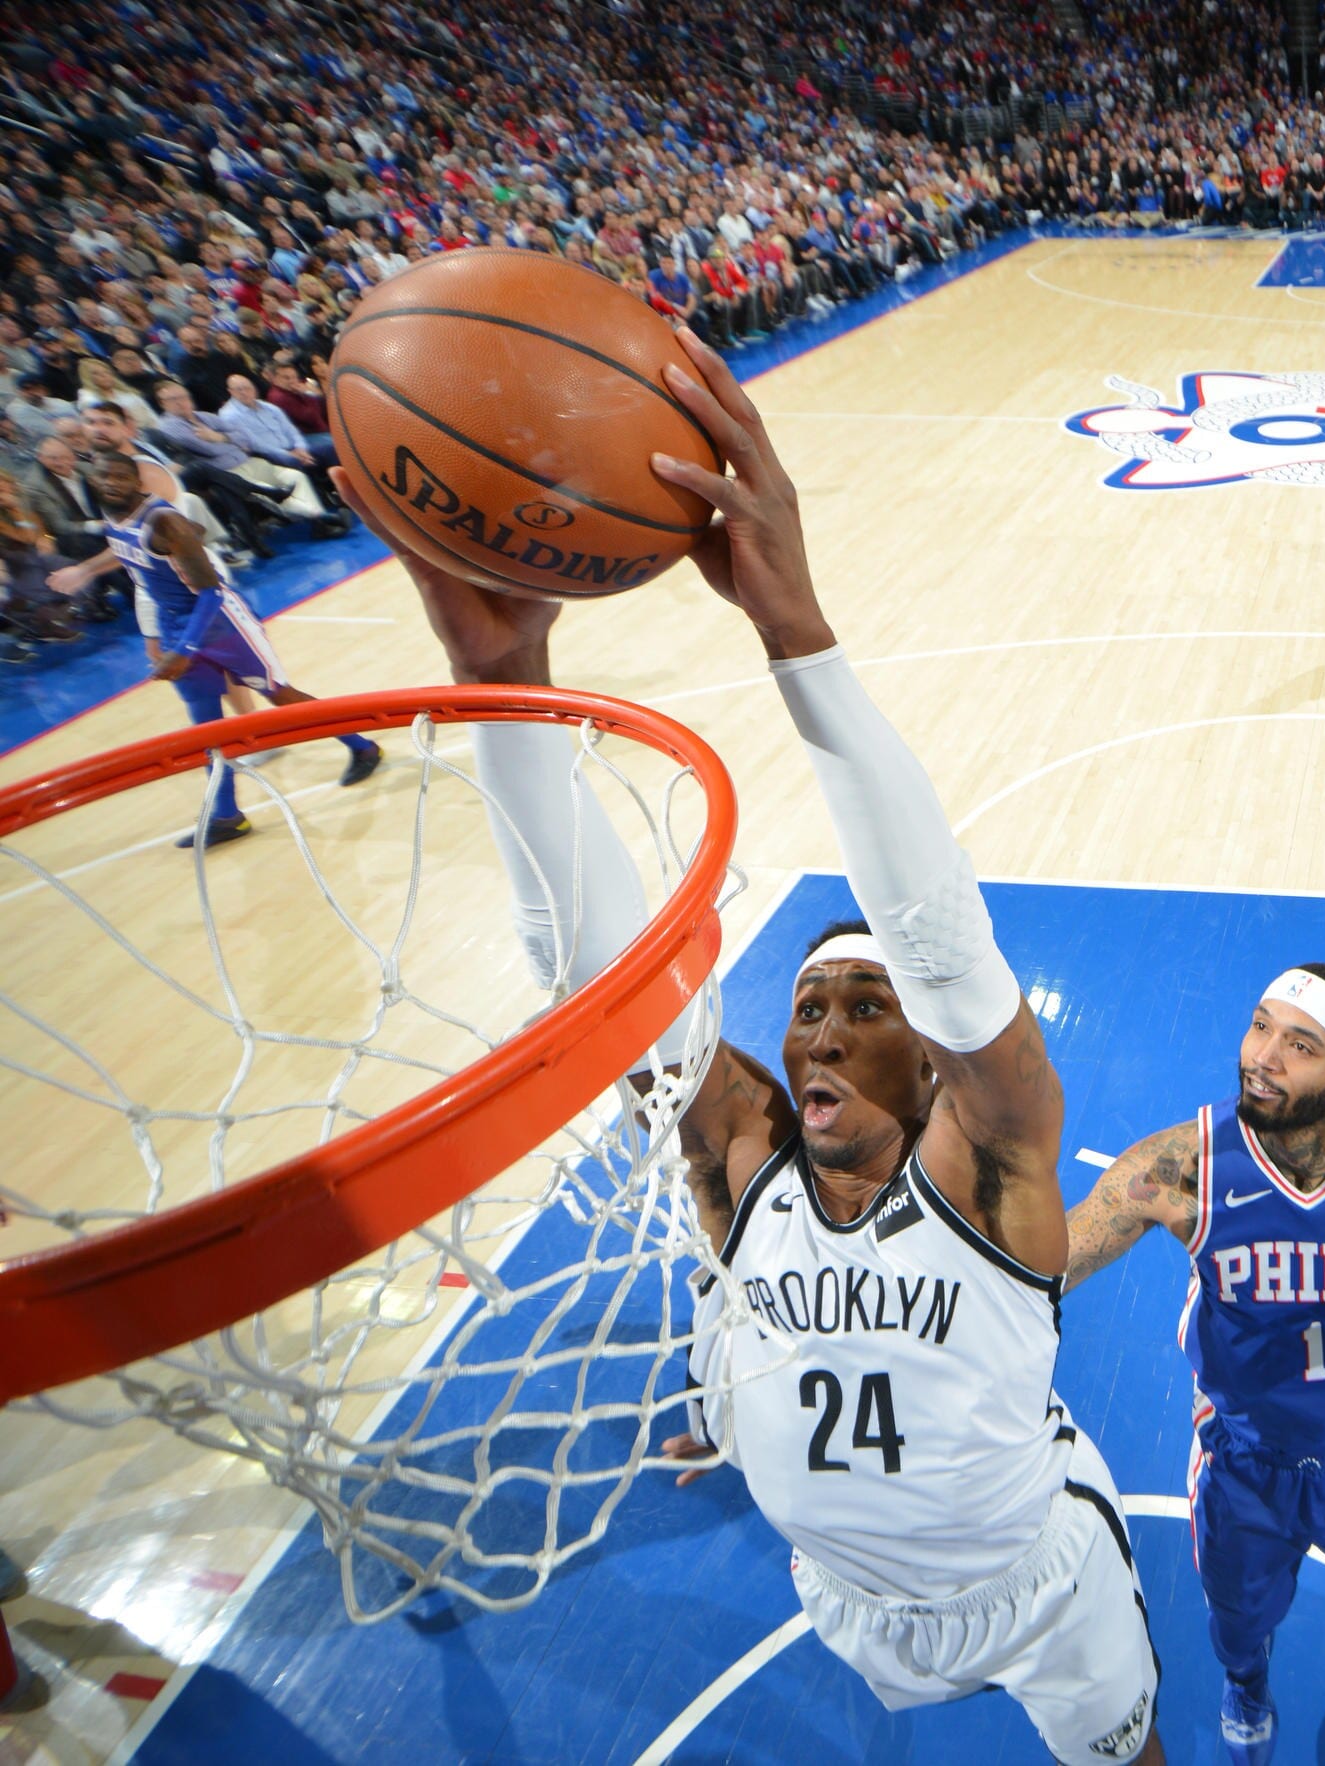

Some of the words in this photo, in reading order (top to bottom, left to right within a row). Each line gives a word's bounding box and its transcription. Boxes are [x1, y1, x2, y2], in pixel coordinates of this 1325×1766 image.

[380, 444, 660, 587] SPALDING
[743, 1265, 961, 1345] BROOKLYN
[799, 1368, 906, 1475] 24
